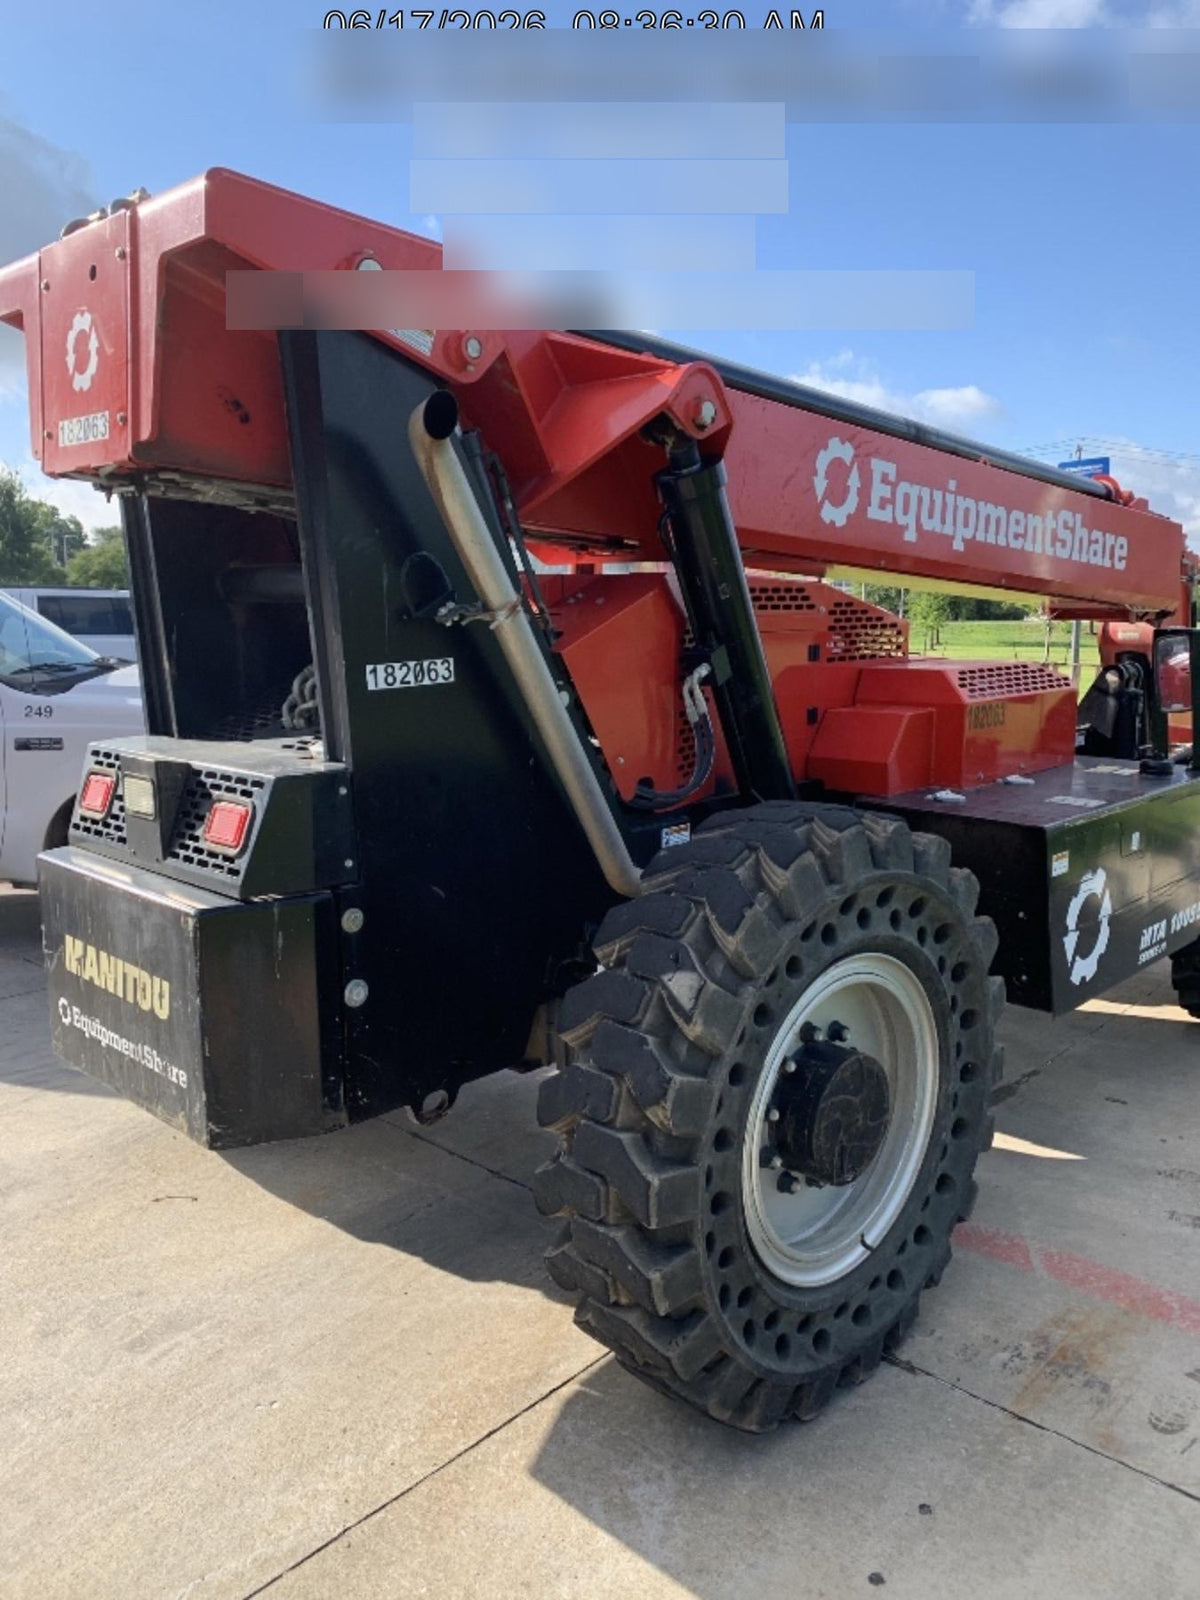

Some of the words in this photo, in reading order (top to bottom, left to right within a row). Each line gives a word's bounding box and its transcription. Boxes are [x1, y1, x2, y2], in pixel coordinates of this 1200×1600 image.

[60, 413, 108, 444] 182063
[867, 457, 1128, 570] EquipmentShare
[368, 658, 453, 689] 182063
[24, 704, 53, 719] 249
[967, 702, 1006, 732] 182063
[65, 934, 170, 1020] MANITOU
